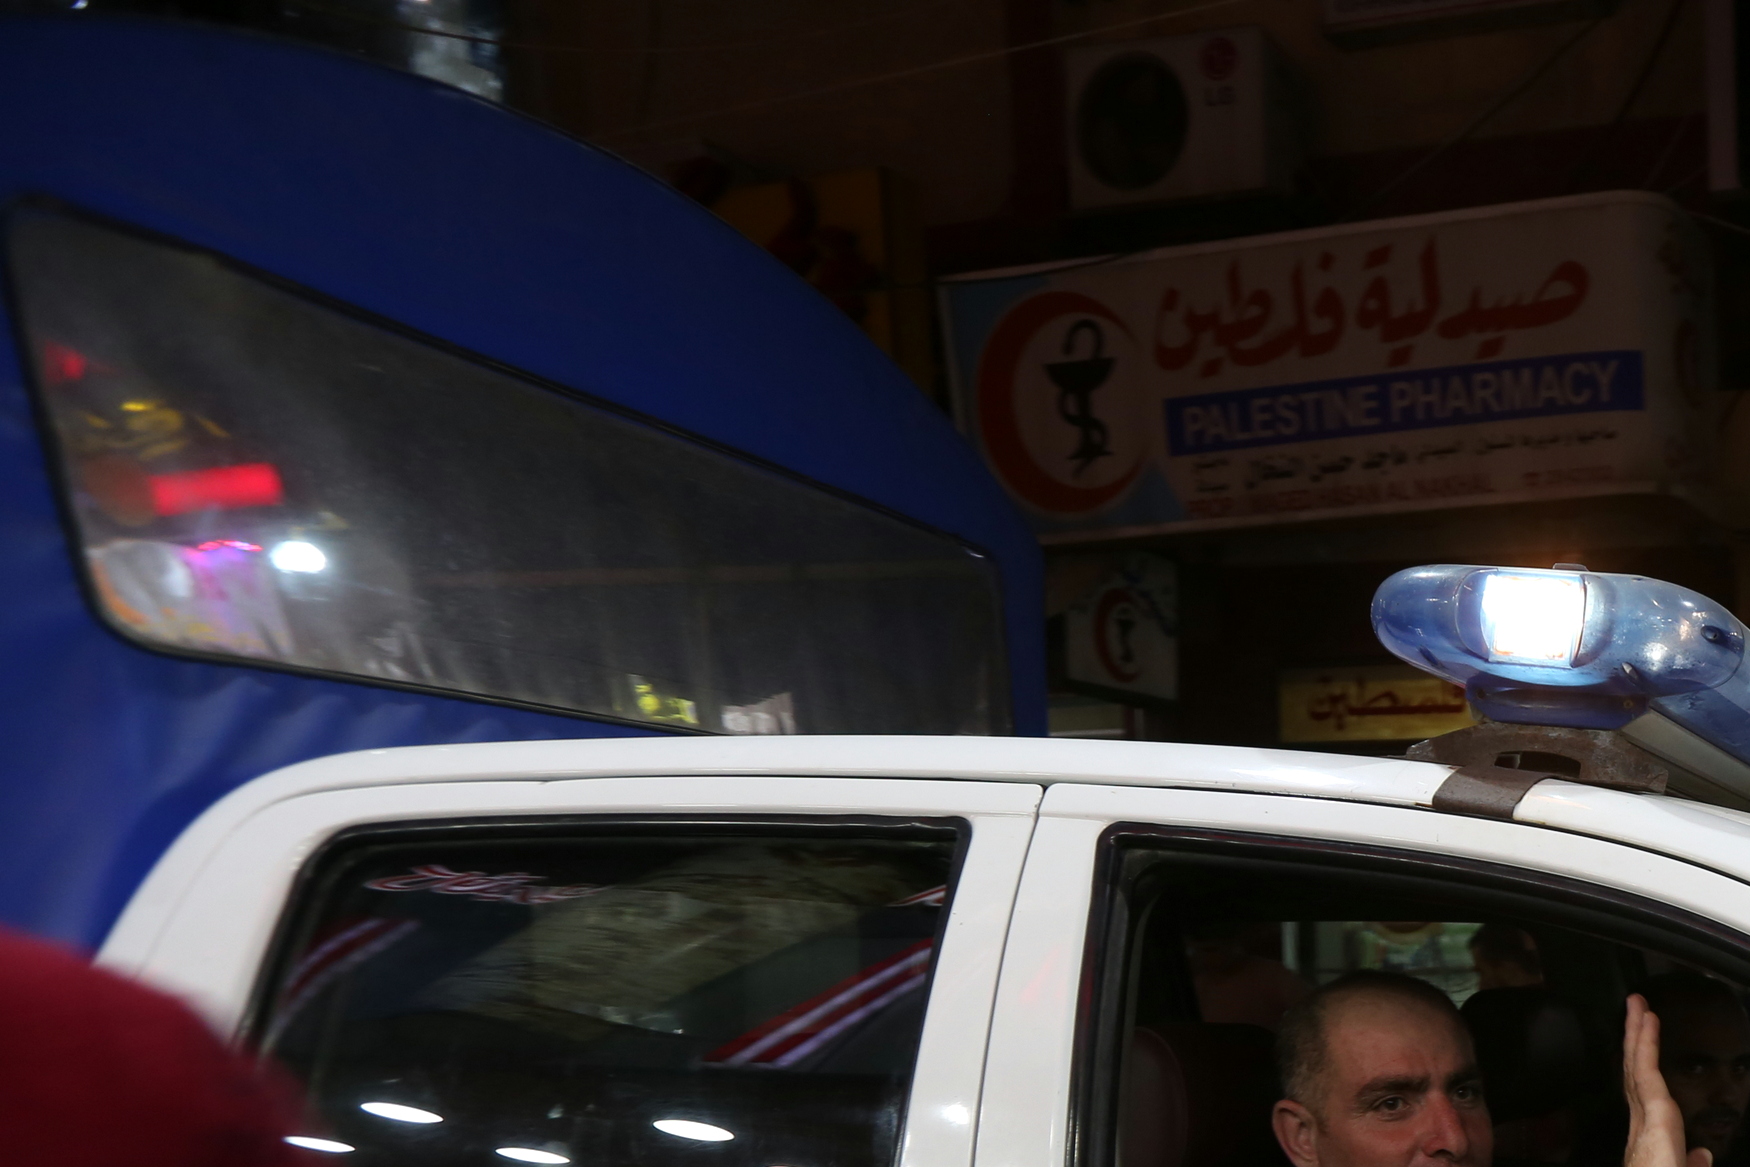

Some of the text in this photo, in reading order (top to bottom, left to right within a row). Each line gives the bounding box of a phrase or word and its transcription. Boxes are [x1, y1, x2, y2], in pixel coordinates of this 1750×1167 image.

[1204, 86, 1236, 106] LG
[1155, 251, 1344, 378] فلسطين
[1356, 236, 1589, 368] صيدلية
[1181, 384, 1382, 448] PALESTINE
[1389, 360, 1621, 423] PHARMACY
